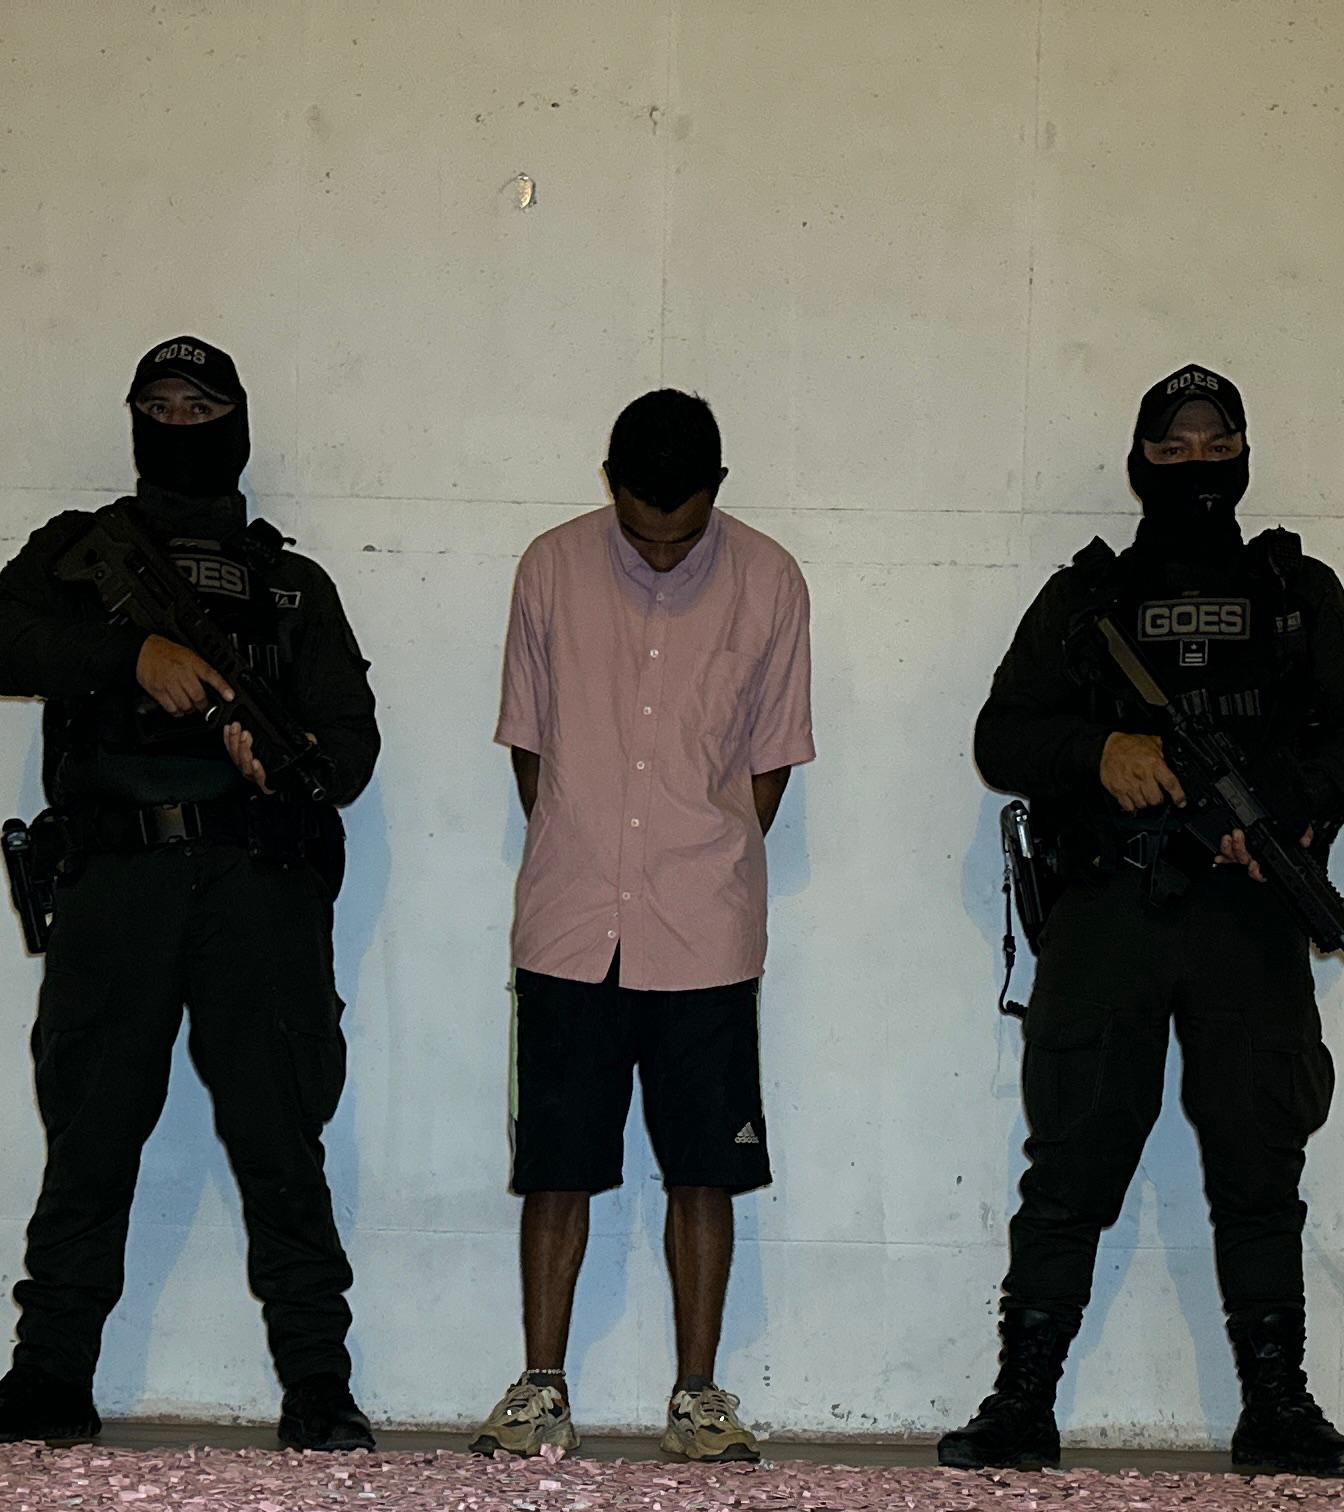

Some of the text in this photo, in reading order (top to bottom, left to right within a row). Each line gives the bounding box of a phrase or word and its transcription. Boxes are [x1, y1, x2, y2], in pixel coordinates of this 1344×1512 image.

[155, 344, 206, 364] GOES
[1167, 371, 1218, 394] GOES
[175, 560, 243, 592] OES
[1145, 605, 1242, 635] GOES
